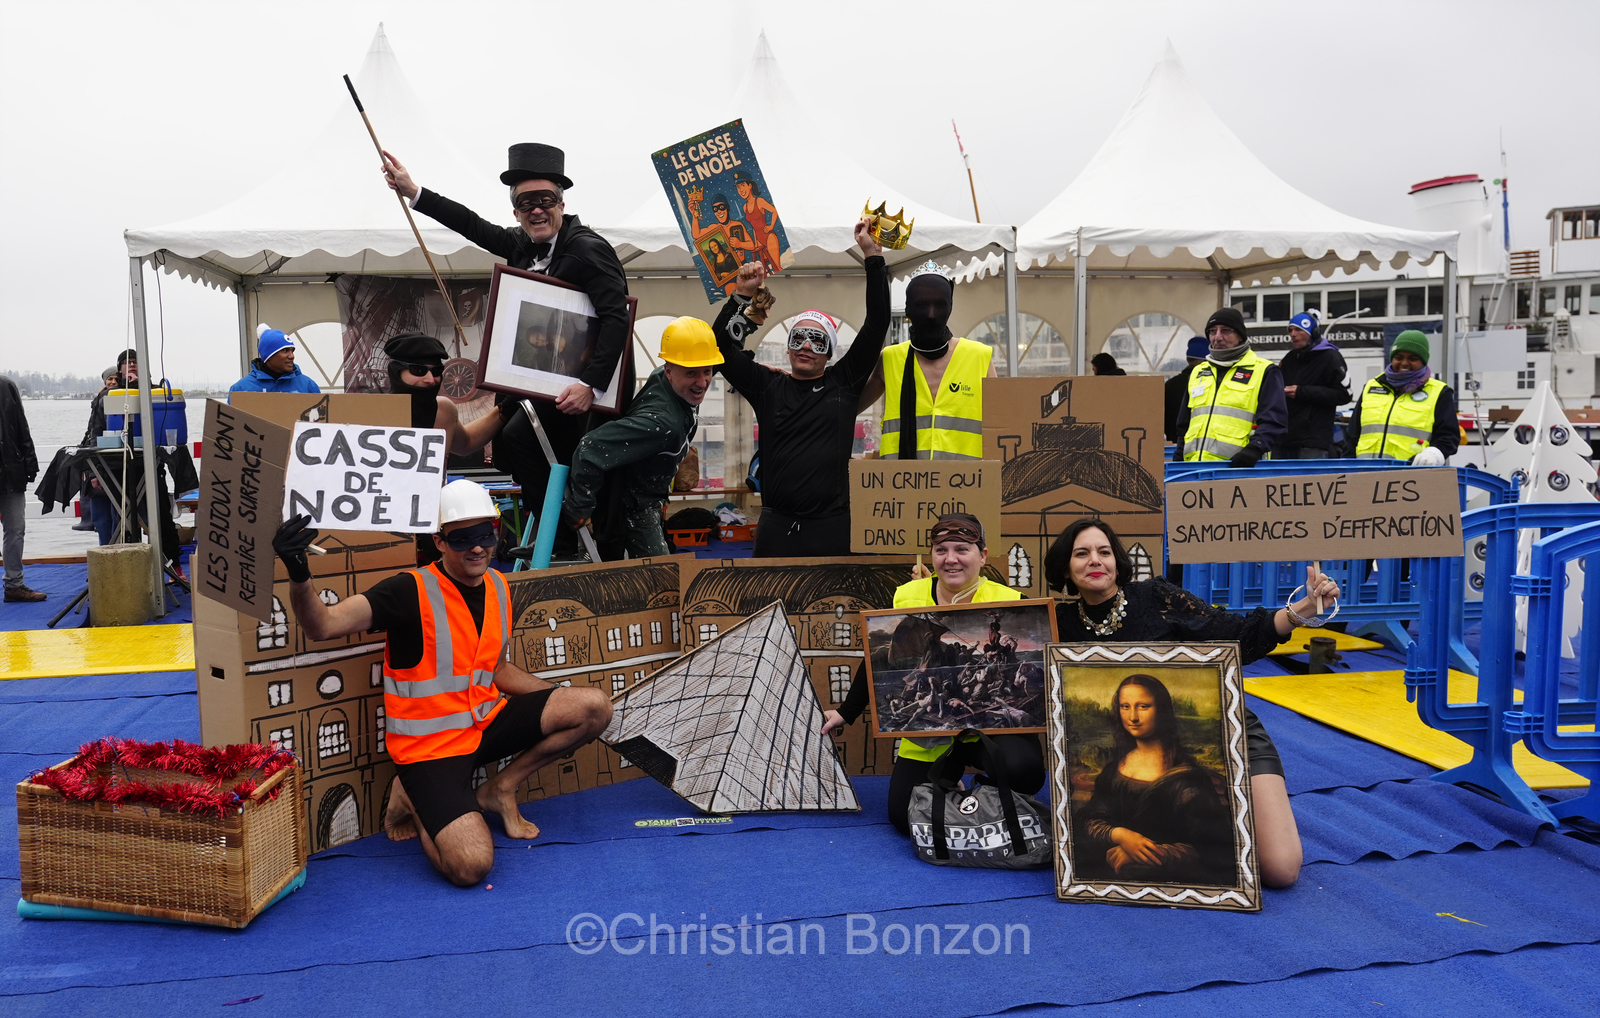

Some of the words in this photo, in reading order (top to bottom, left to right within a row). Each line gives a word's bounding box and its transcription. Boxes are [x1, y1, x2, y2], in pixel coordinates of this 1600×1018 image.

[670, 151, 689, 170] LE
[688, 132, 735, 163] CASSE
[677, 168, 697, 187] DE
[695, 150, 742, 181] NOËL
[1247, 334, 1293, 344] NSERTIO
[1322, 330, 1357, 341] RÉES
[1358, 331, 1367, 340] &
[214, 404, 236, 462] VONT
[295, 427, 445, 474] CASSE
[344, 471, 384, 494] DE
[861, 471, 884, 489] UN
[892, 471, 941, 489] CRIME
[1181, 487, 1214, 509] ON
[1230, 485, 1248, 509] A
[1266, 474, 1348, 508] RELEVÉ
[1371, 480, 1420, 504] LES
[209, 470, 232, 550] BIJOUX
[289, 488, 432, 527] NOËL
[864, 528, 906, 546] DANS
[1172, 520, 1309, 544] SAMOTHRACES
[206, 552, 229, 593] LES
